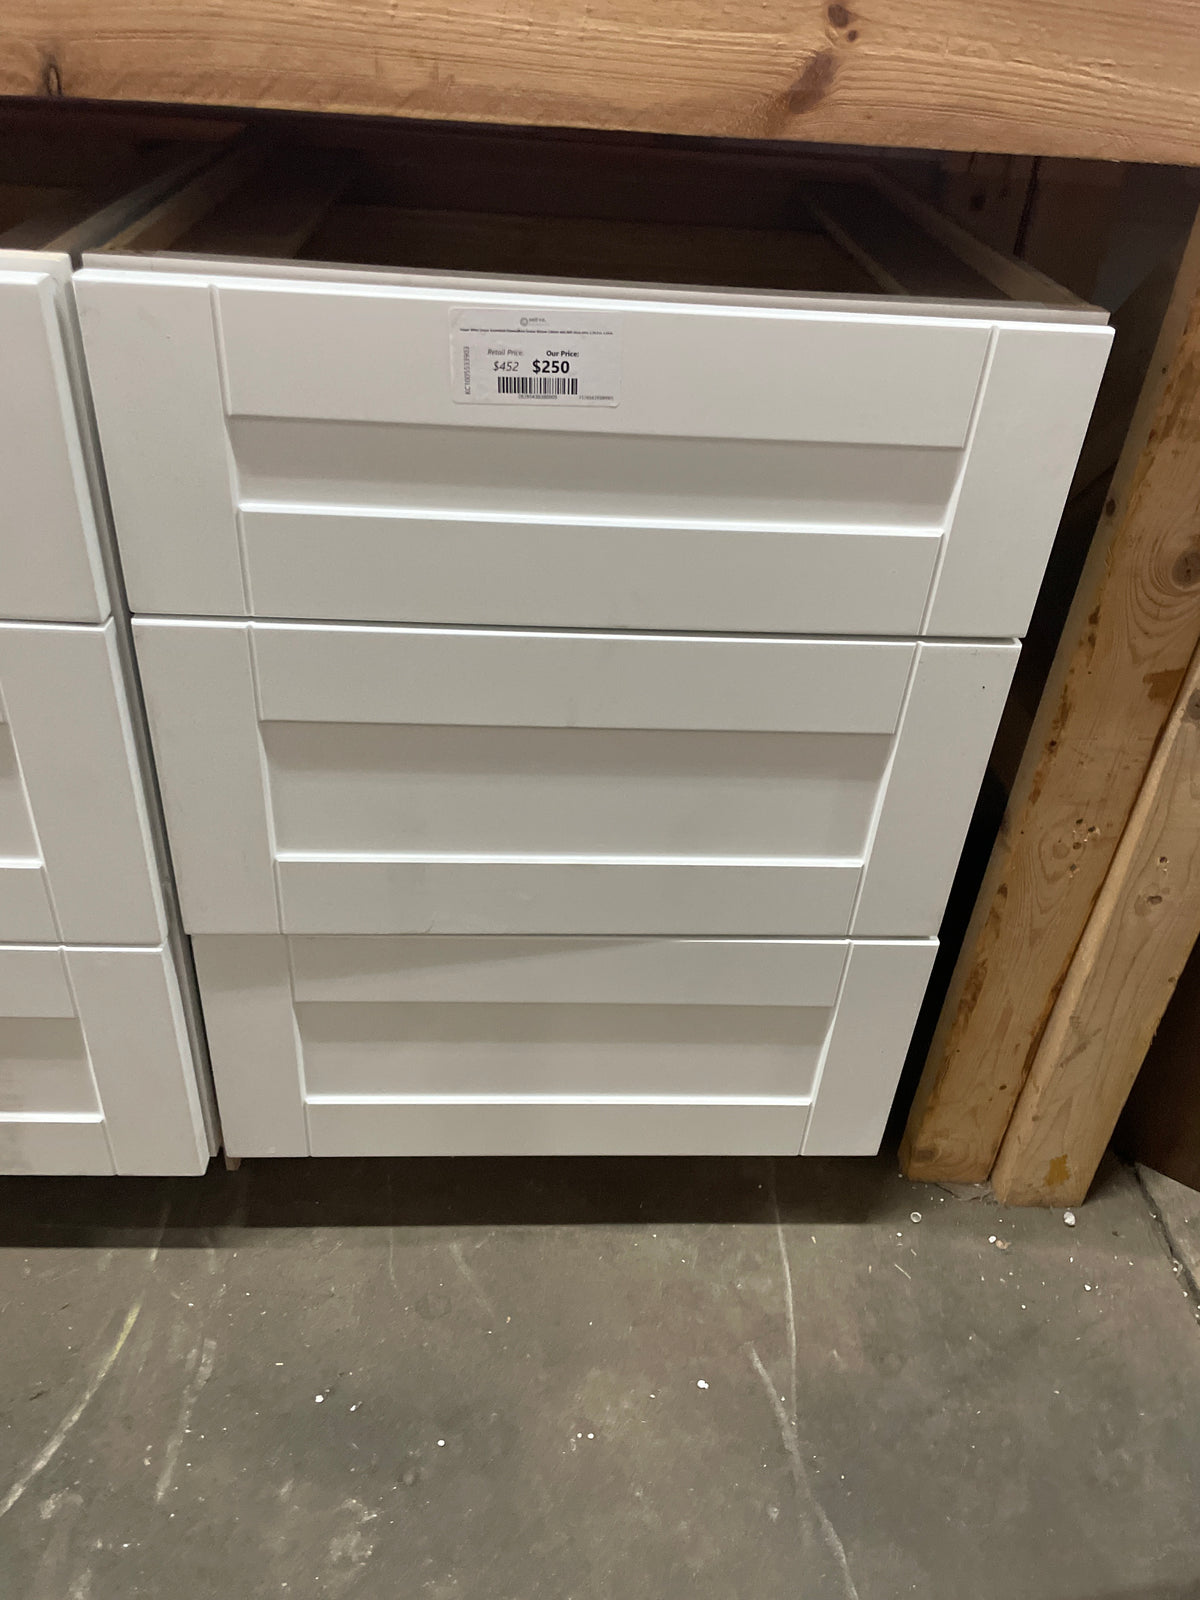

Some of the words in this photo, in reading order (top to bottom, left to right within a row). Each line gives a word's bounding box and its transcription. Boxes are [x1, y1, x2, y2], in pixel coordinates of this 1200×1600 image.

[487, 348, 505, 356] Retail
[560, 349, 579, 358] Price:
[493, 360, 519, 372] $452
[532, 358, 570, 374] $250
